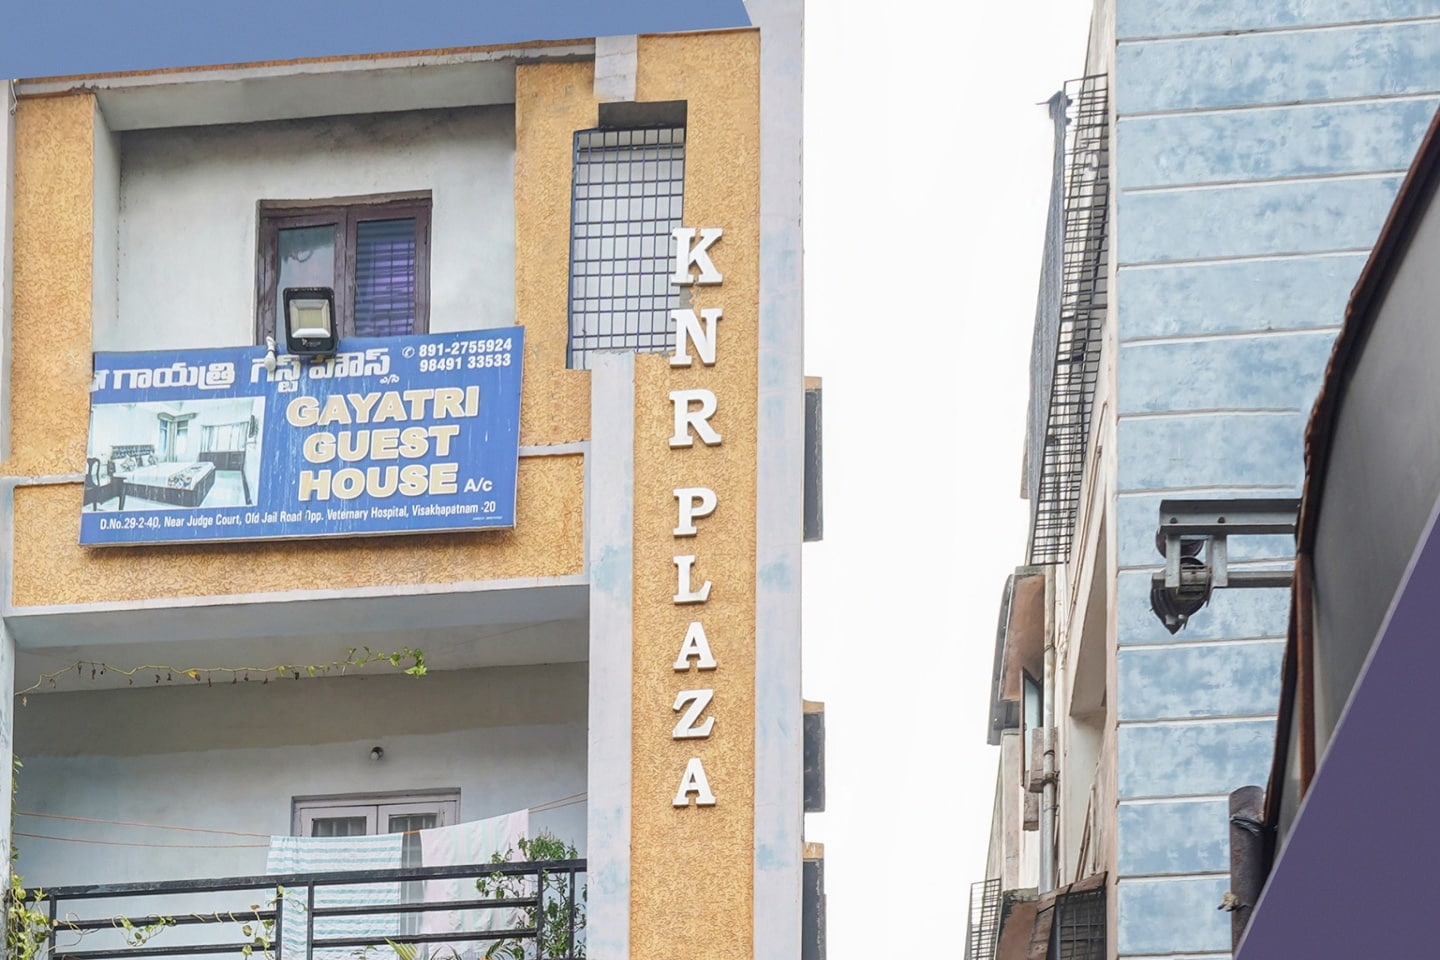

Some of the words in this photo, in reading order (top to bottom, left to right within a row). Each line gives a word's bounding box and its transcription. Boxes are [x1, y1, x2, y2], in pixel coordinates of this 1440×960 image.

[419, 338, 513, 358] 891-2755924
[669, 227, 723, 450] KNR
[420, 356, 462, 373] 98491
[467, 354, 512, 369] 33533
[286, 385, 480, 427] GAYATRI
[303, 424, 460, 464] GUEST
[298, 462, 459, 501] HOUSE
[464, 477, 493, 493] A/c
[164, 515, 185, 528] Near
[187, 514, 214, 529] Judge
[215, 513, 242, 527] Court,
[245, 512, 260, 524] Old
[262, 511, 278, 523] Jail
[280, 510, 302, 522] Road
[371, 505, 410, 519] Hospital,
[412, 502, 479, 517] Visakhapatnam
[672, 487, 717, 808] PLAZA
